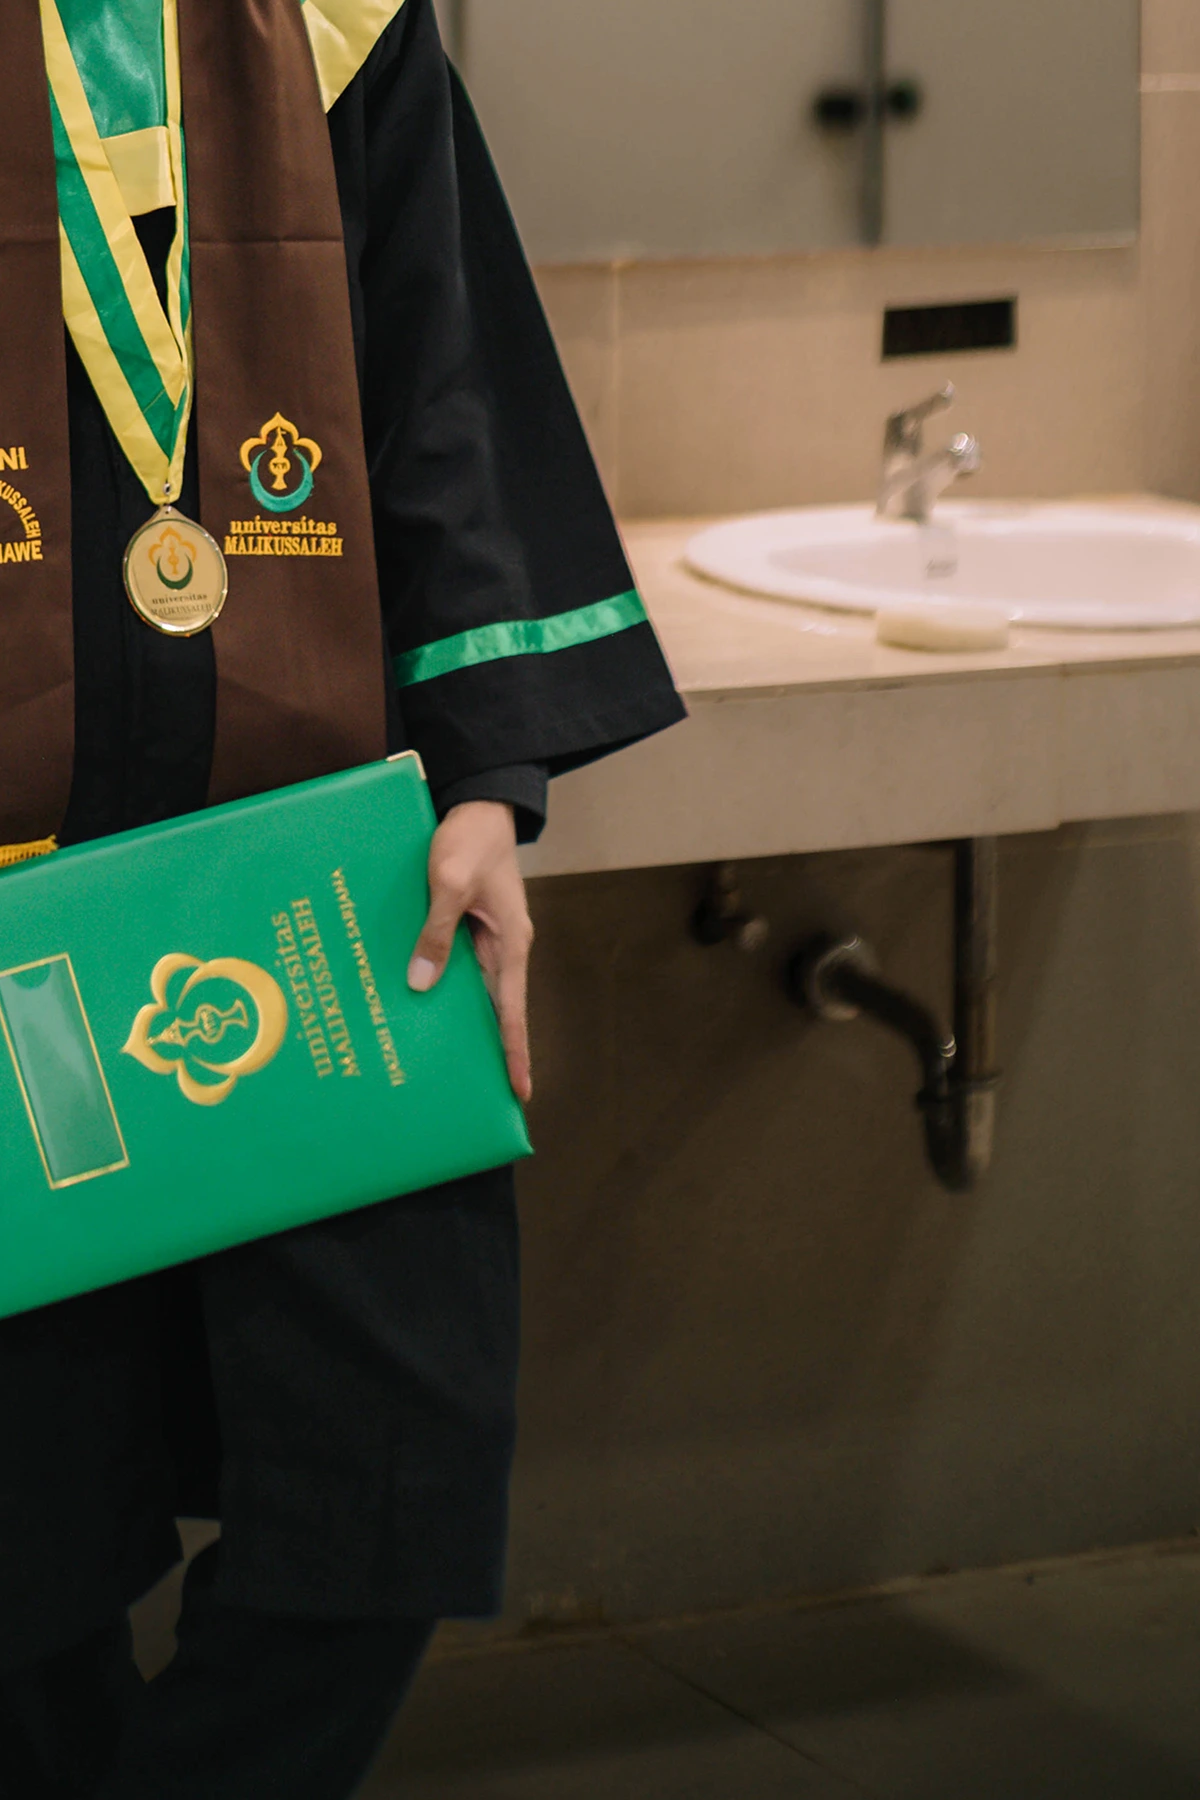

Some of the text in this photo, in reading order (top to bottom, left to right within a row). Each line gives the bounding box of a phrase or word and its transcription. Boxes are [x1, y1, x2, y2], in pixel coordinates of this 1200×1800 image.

[224, 536, 343, 556] MALIKUSSALEH
[230, 515, 337, 536] universitas
[152, 593, 208, 605] universitas
[330, 866, 361, 939] SARJANA
[271, 911, 334, 1078] universitas
[290, 897, 361, 1077] MALIKUSSALEH
[349, 940, 386, 1026] PROGRAM
